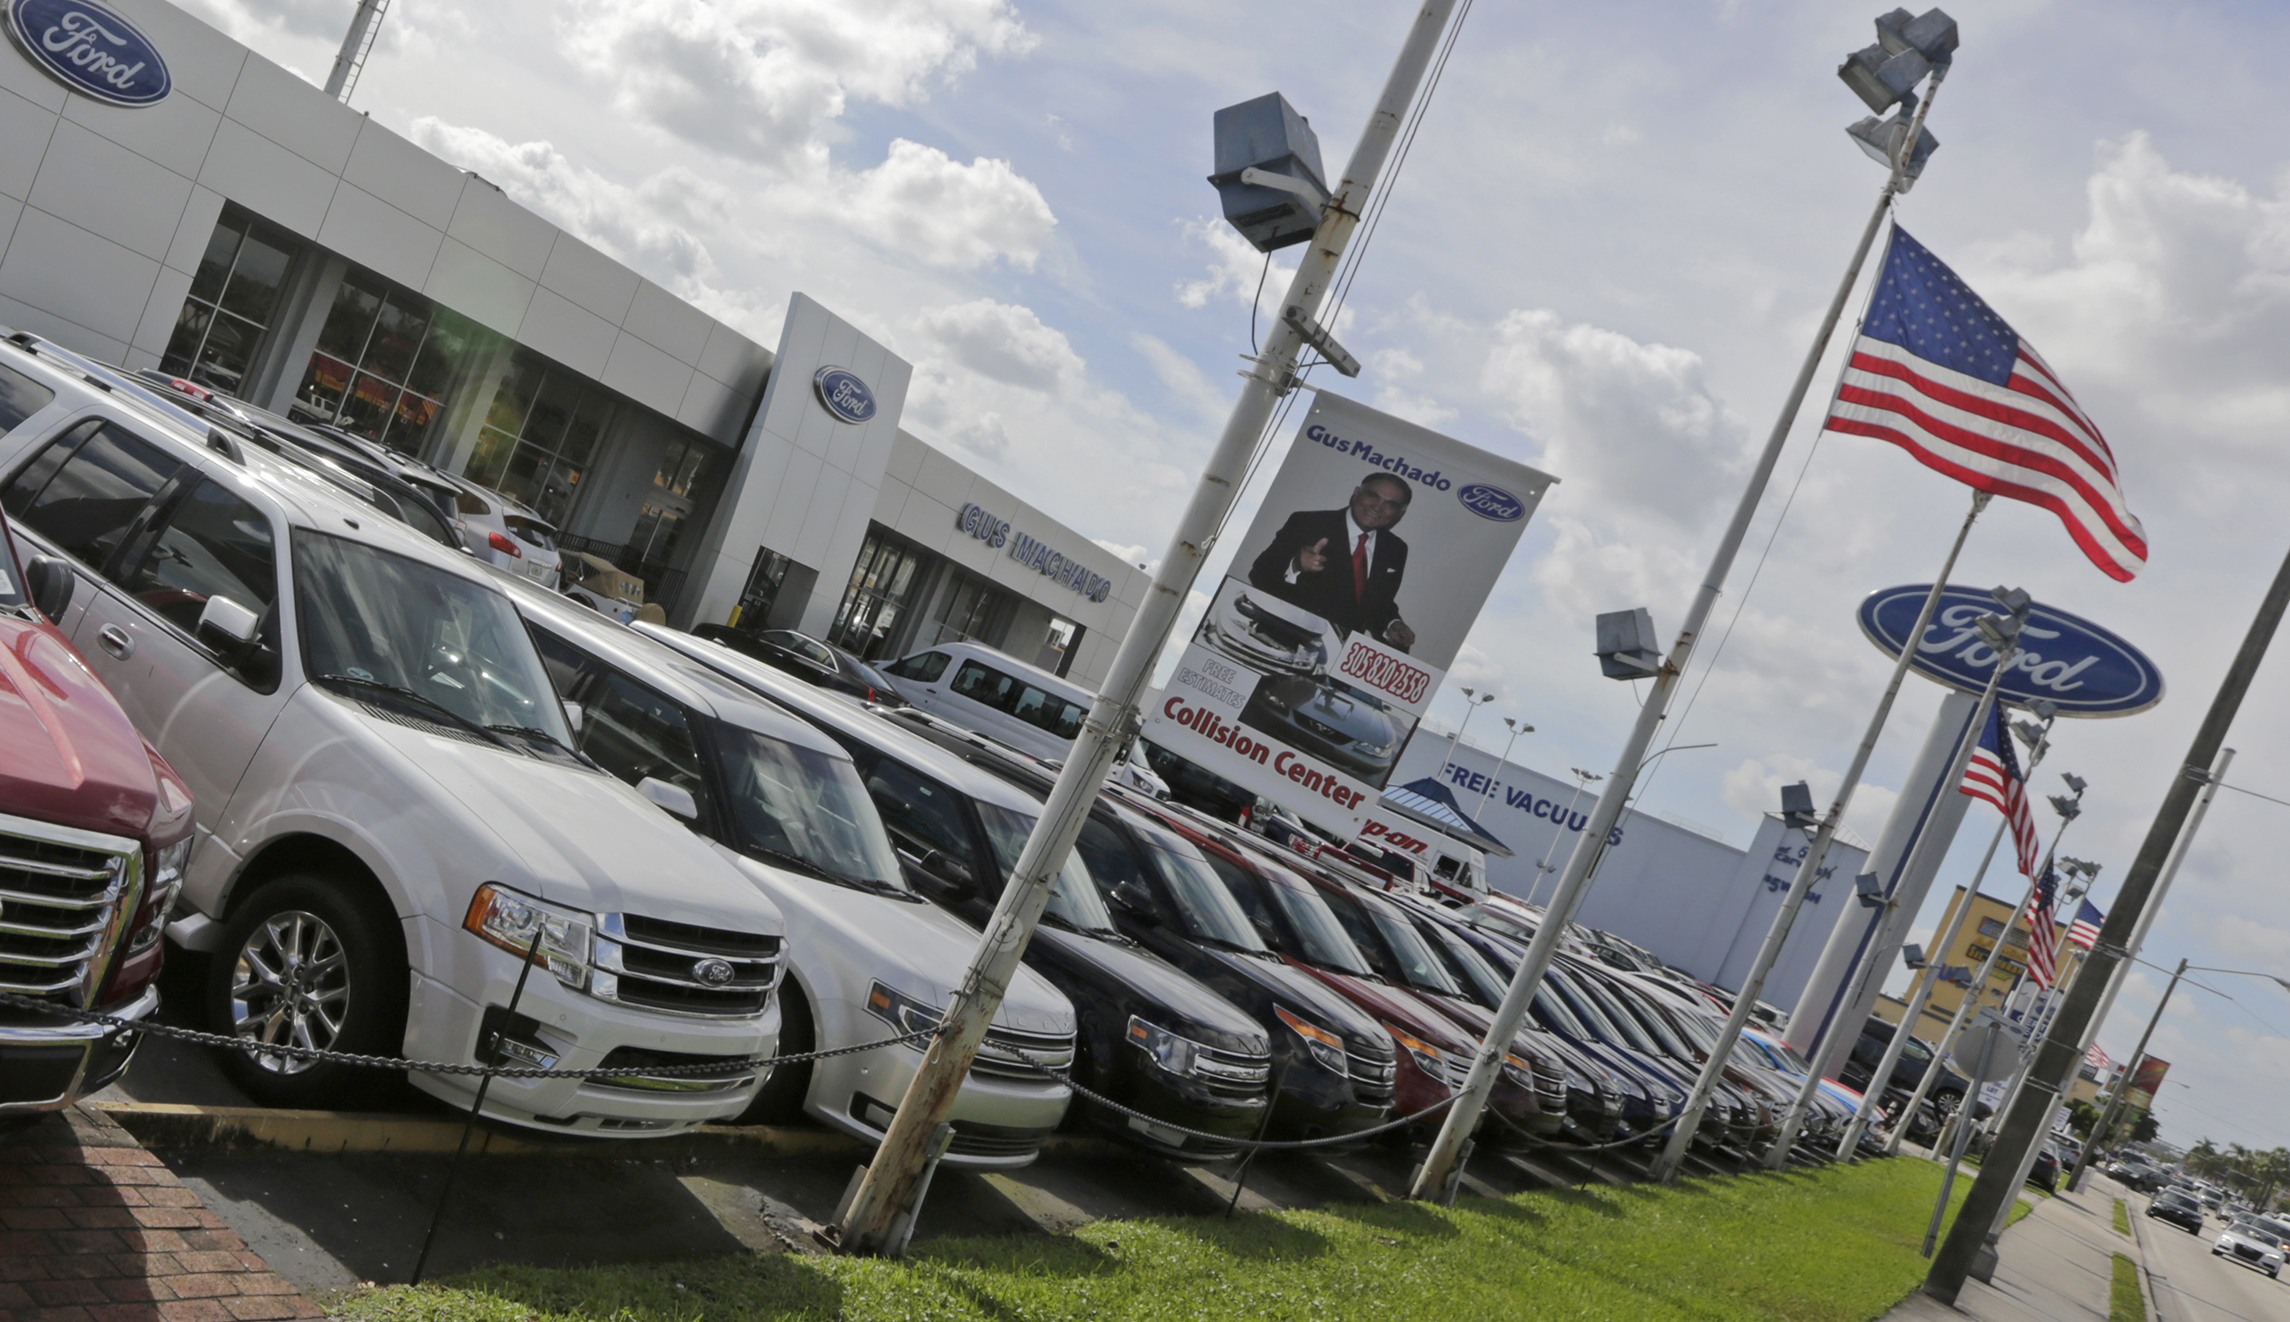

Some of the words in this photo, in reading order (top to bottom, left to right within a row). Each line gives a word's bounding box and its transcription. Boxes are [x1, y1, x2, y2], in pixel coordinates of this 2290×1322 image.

[42, 11, 146, 89] Ford
[832, 379, 869, 416] Ford
[1349, 440, 1451, 492] Machado
[1462, 485, 1519, 519] Ford
[958, 502, 1011, 549] GUS
[1011, 531, 1112, 604] MACHADO
[1202, 658, 1237, 685] FREE
[1917, 604, 2101, 692] Ford
[1177, 667, 1247, 710] ESTIMATES
[1163, 696, 1270, 765] Collision
[1274, 751, 1366, 811] Center
[1437, 760, 1500, 799] FREE
[1505, 785, 1625, 846] VACUUS
[708, 965, 730, 981] Ford
